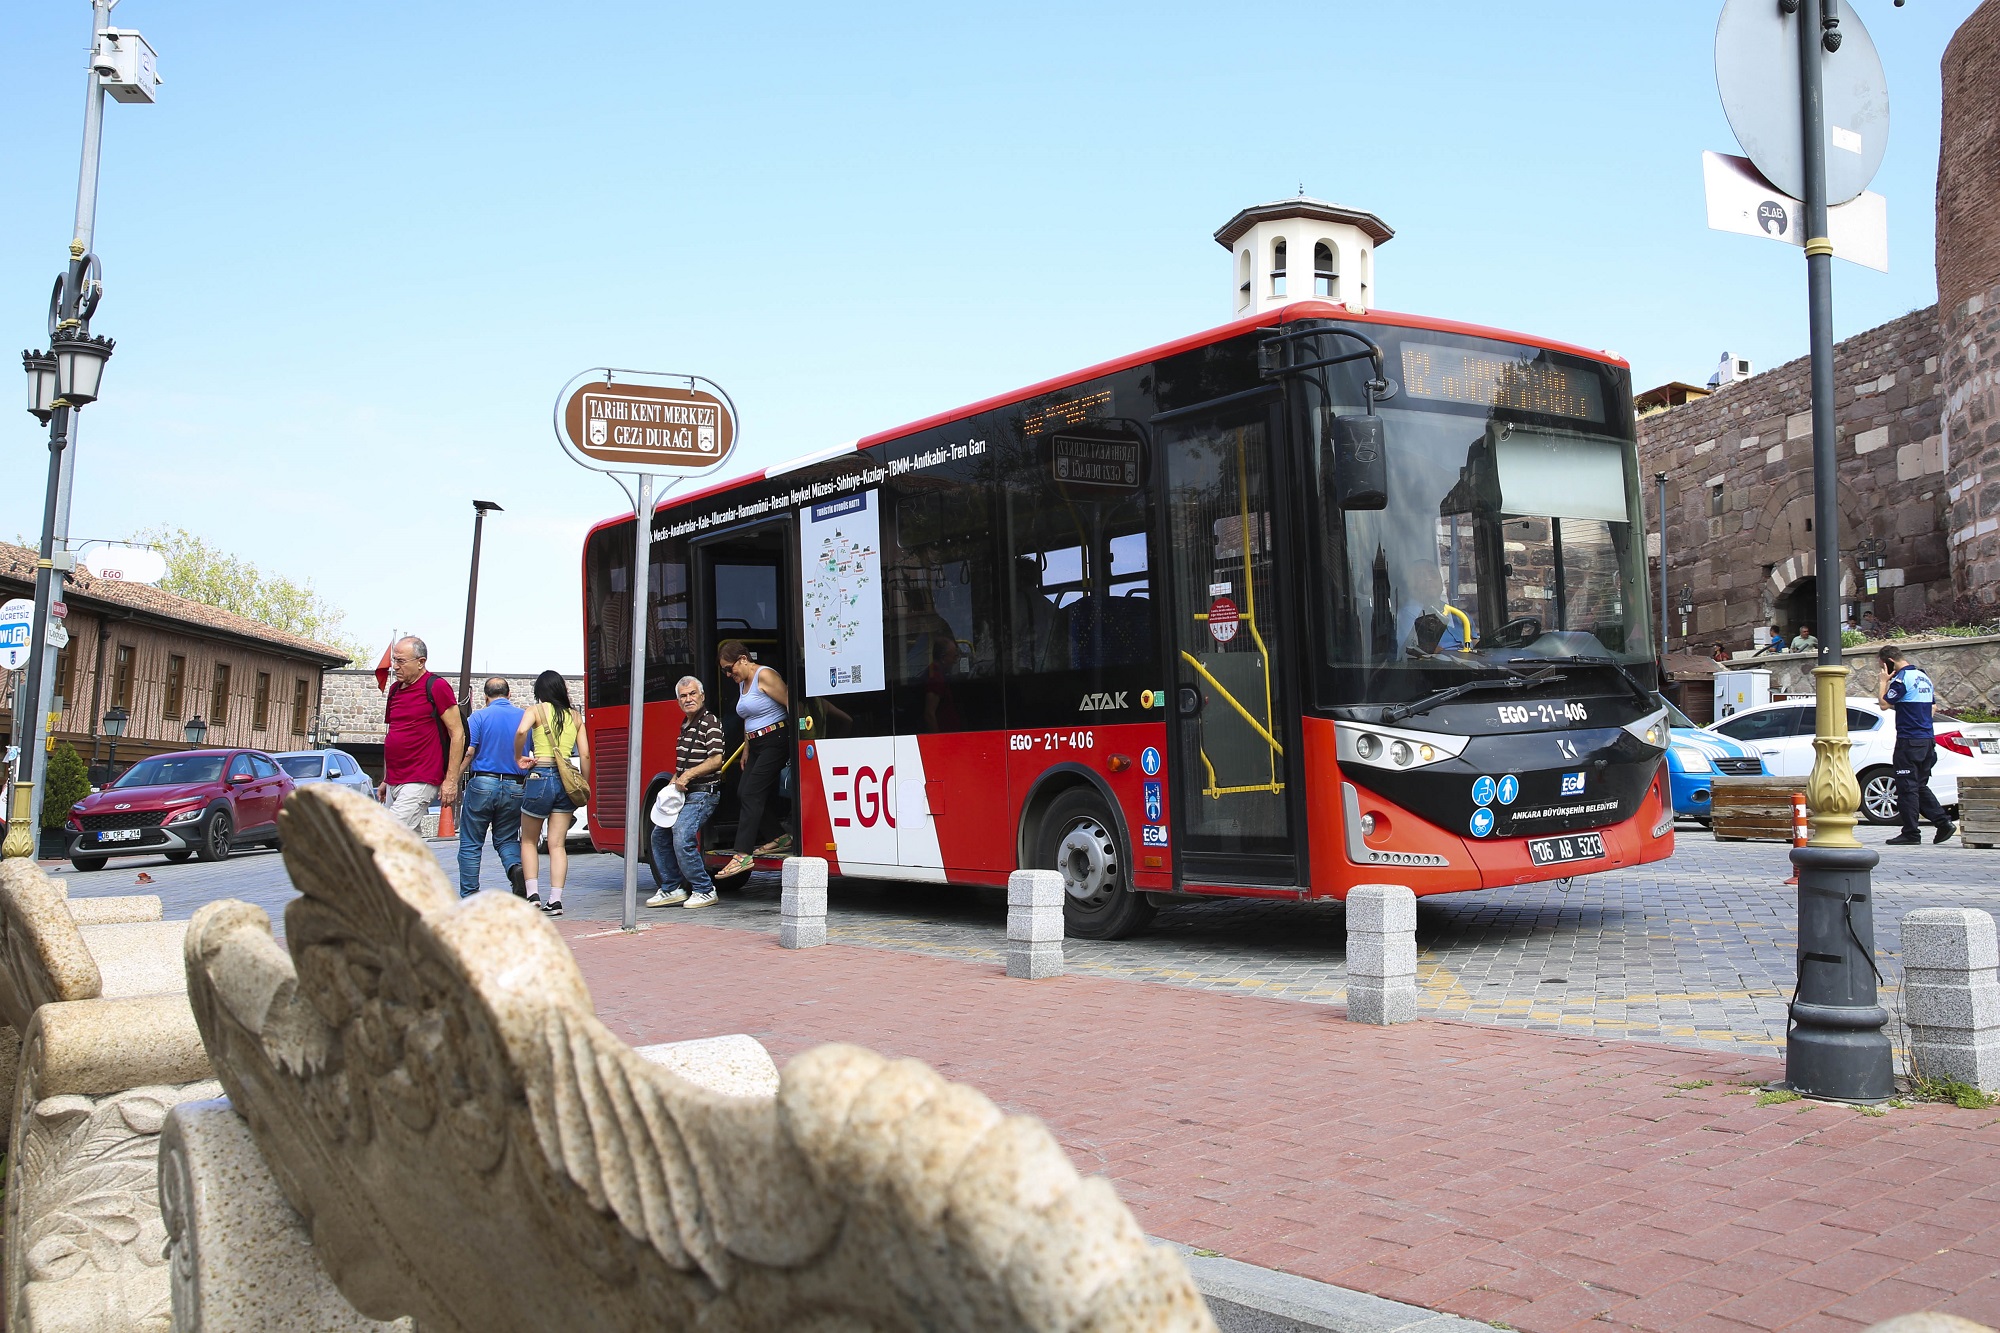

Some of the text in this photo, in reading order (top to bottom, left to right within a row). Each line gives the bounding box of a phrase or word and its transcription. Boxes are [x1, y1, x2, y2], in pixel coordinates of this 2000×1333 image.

[1760, 206, 1783, 219] SLAB
[590, 399, 715, 427] TARİHİ KENT MERKEZİ
[614, 425, 693, 449] GEZİ DURAĞI
[969, 438, 986, 456] Garı
[102, 570, 121, 579] EGO
[0, 610, 30, 621] ÜCRETSİZ
[1079, 691, 1129, 711] ATAK
[1511, 799, 1619, 820] ANKARA BÜYÜKŞEHİR BELEDİYESİ
[1537, 835, 1603, 862] 06 AB 5213
